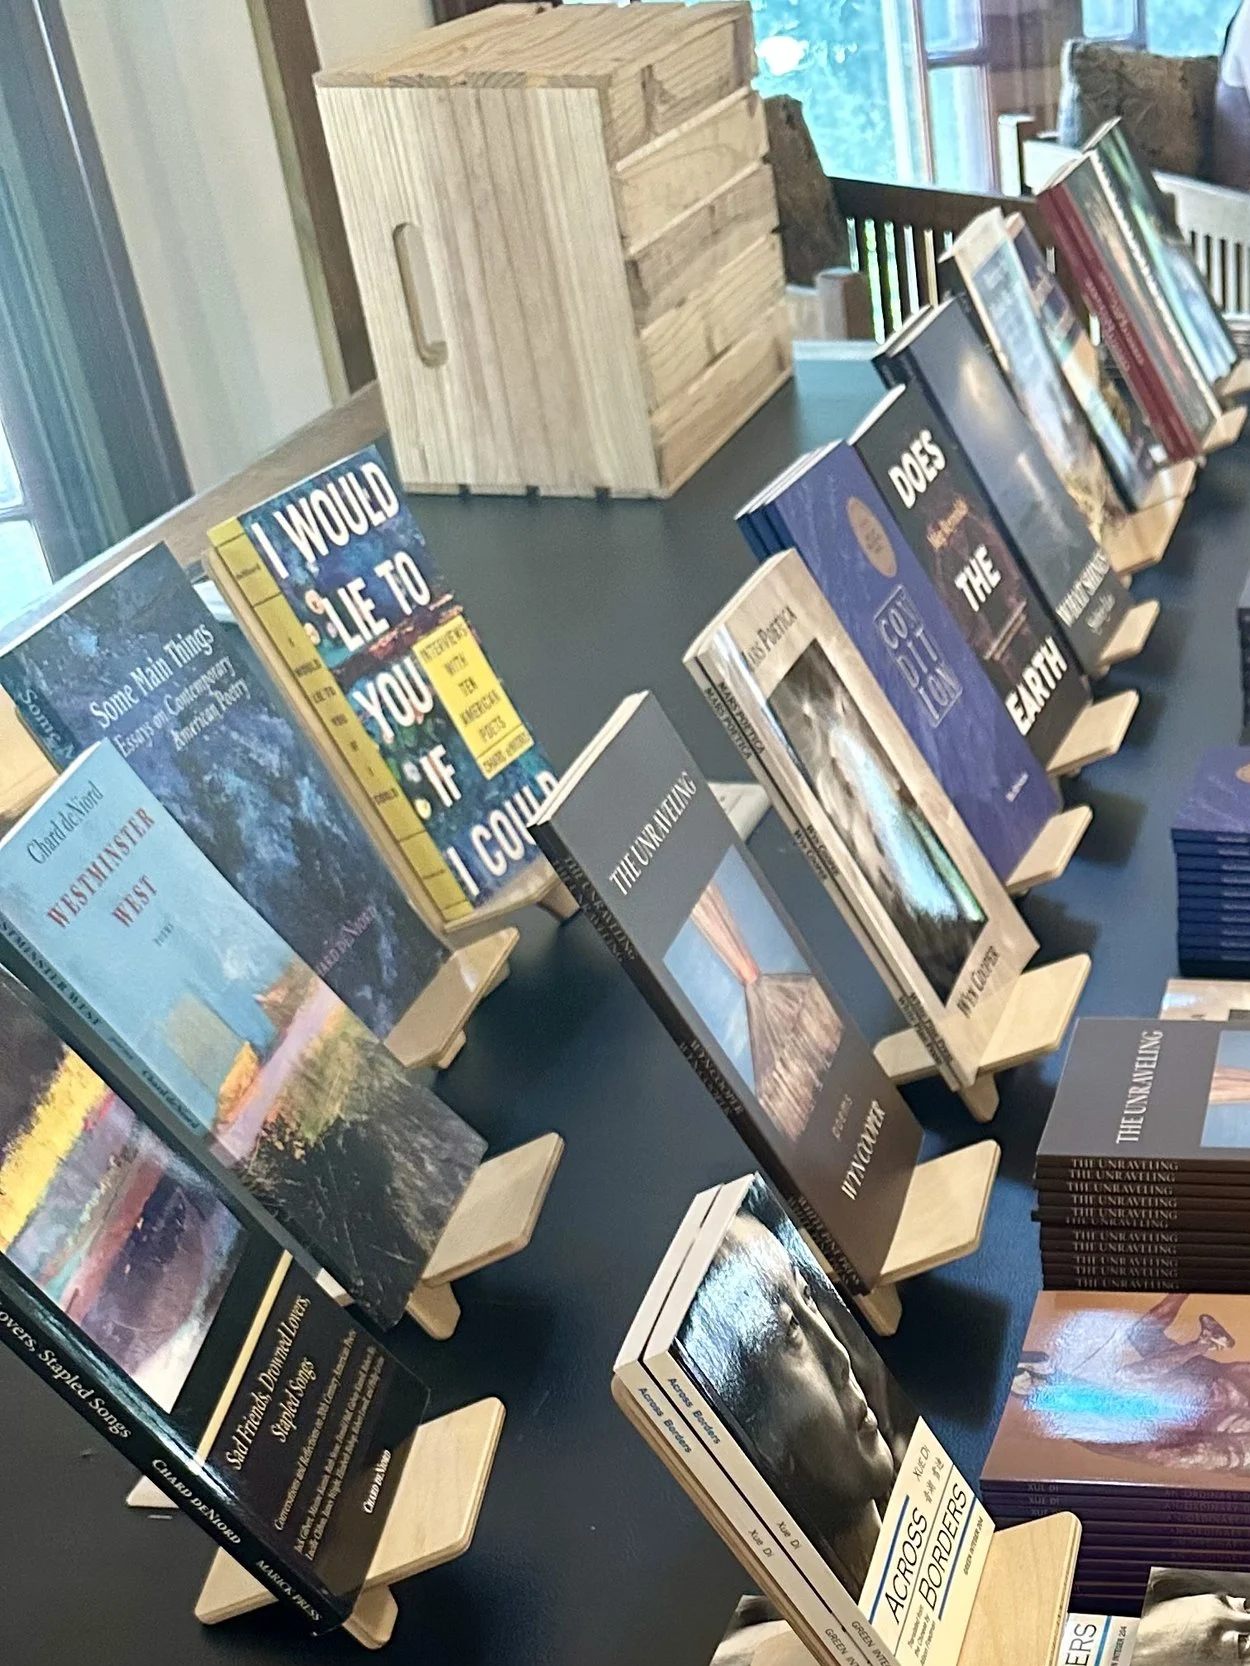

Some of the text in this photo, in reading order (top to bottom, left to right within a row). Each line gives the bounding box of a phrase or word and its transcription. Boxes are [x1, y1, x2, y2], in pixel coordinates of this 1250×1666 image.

[888, 429, 946, 509] DOES
[251, 461, 400, 579] I WOULD
[322, 551, 431, 651] LIE TO
[955, 545, 1002, 612] THE
[90, 623, 214, 729] Some Main Things
[419, 624, 468, 663] INTERVIEWS
[443, 653, 469, 676] WITH
[458, 677, 478, 696] TEN
[1005, 636, 1068, 736] EARTH
[114, 656, 236, 758] Essays on Contemporary
[170, 677, 251, 751] American Poetry
[352, 656, 434, 744] YOU
[479, 715, 506, 743] POETS
[419, 744, 462, 808] IF
[27, 780, 104, 865] Chard deNiord
[608, 770, 698, 896] THE UNRAVELING
[47, 807, 156, 929] WESTMINSTER
[112, 874, 158, 928] WEST
[445, 846, 480, 897] I
[1116, 1030, 1164, 1144] THE UNRAVELING
[841, 1099, 886, 1200] WYN COOPER
[1072, 1159, 1179, 1171] THE UNRAVELING
[226, 1295, 312, 1470] Sad Friends, Drowned Lovers,
[270, 1357, 318, 1443] Stapled Songs
[38, 1349, 93, 1398] Stapled
[89, 1396, 132, 1439] Songs
[151, 1458, 194, 1498] CHARD
[256, 1559, 294, 1596] MARICK
[291, 1590, 324, 1622] PRESS
[885, 1507, 928, 1625] ACROSS
[918, 1482, 968, 1611] BORDERS
